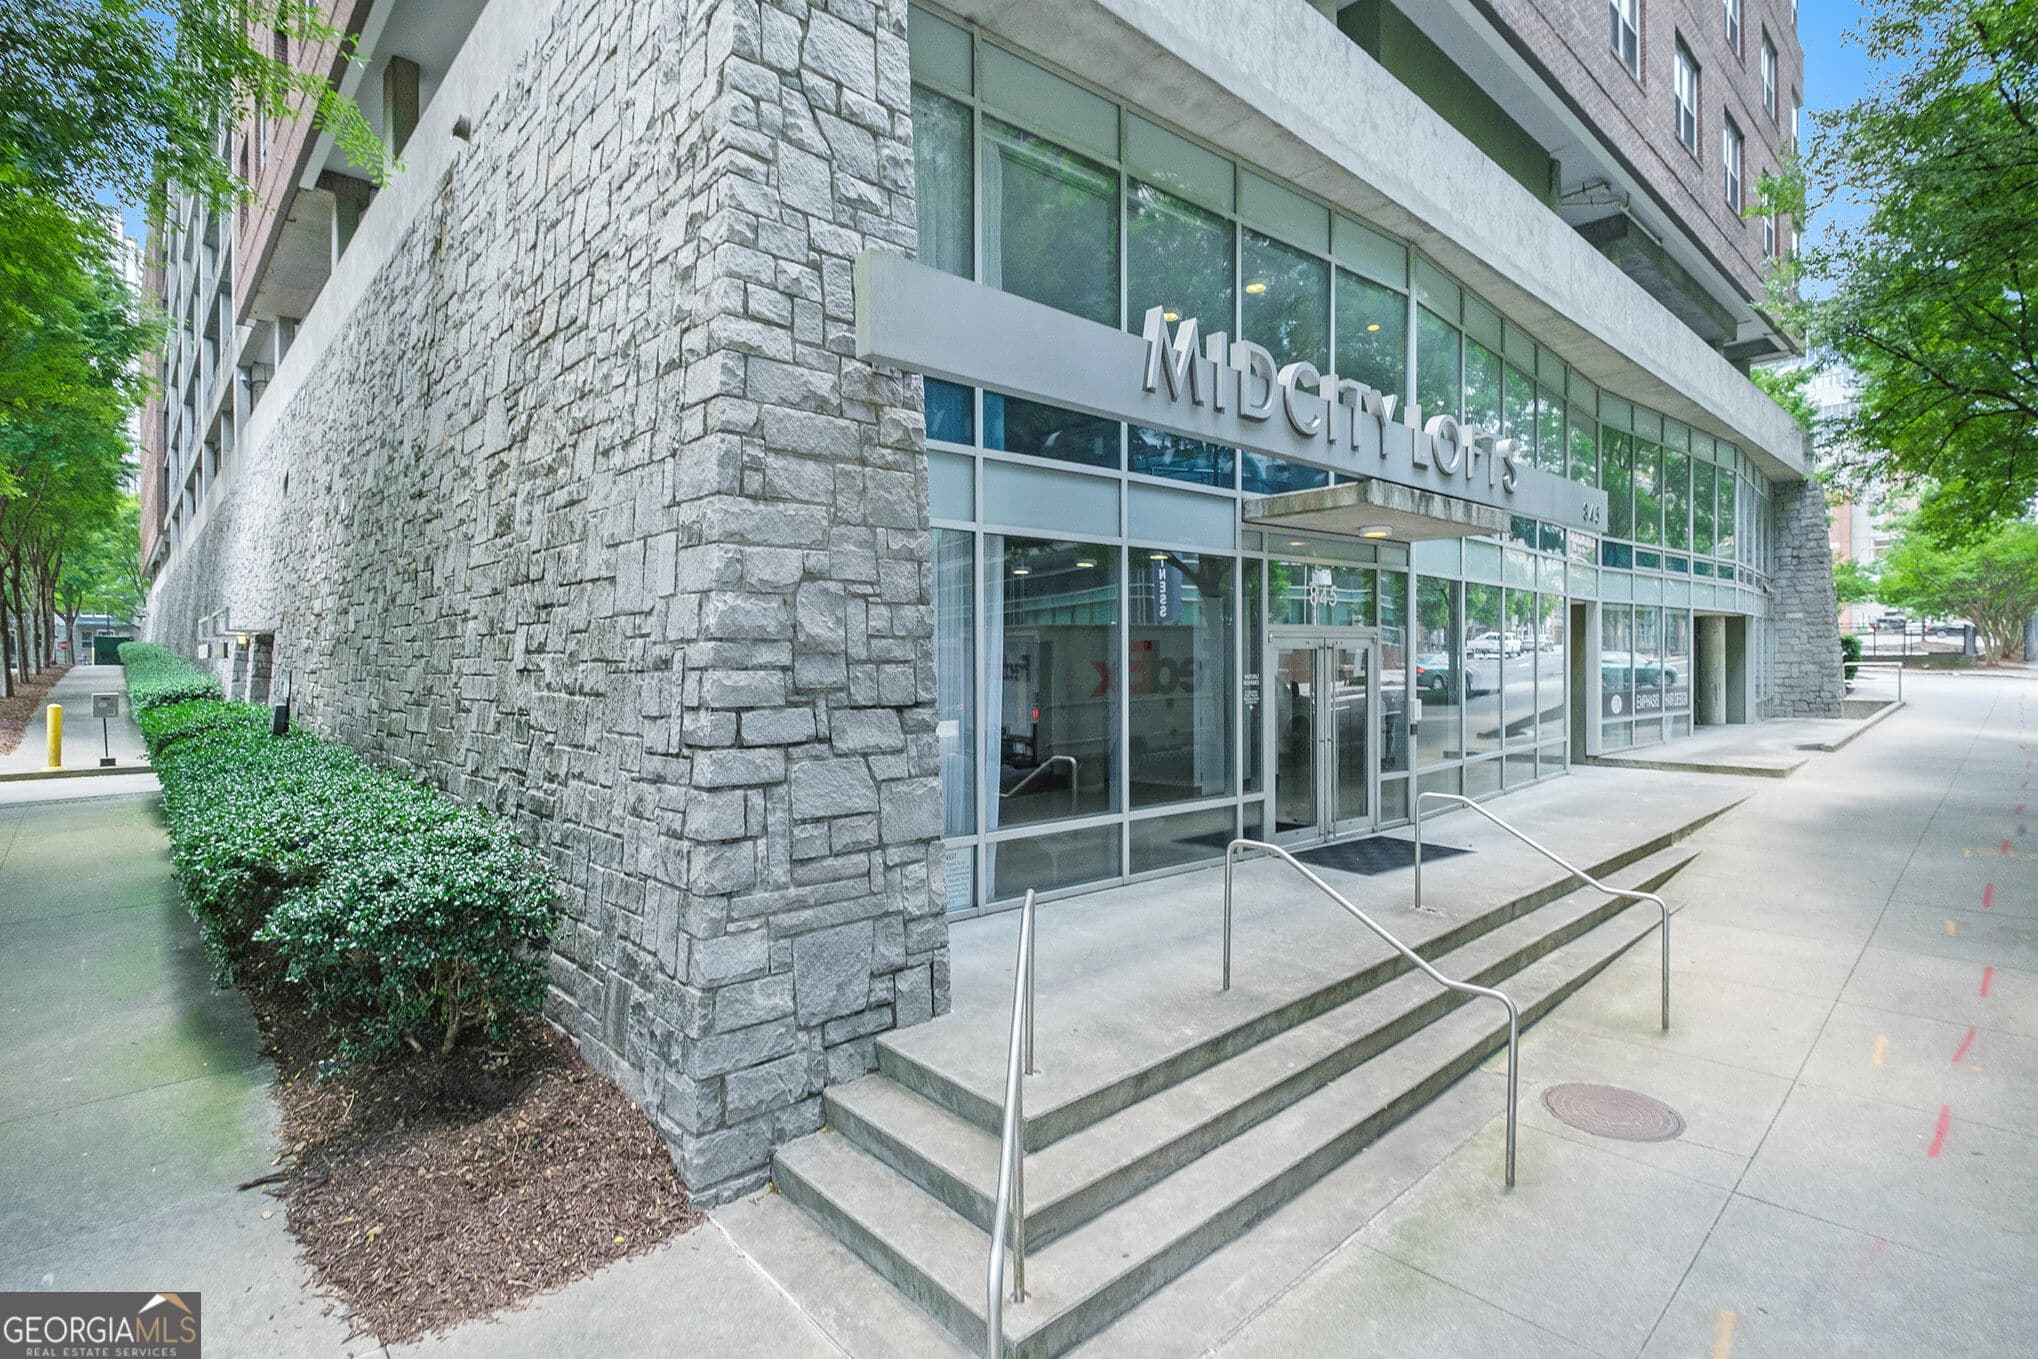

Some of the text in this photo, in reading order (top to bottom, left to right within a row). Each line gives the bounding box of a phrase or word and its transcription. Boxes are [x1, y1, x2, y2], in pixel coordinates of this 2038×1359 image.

[1142, 305, 1518, 495] MIDCITY LOFTS
[1309, 584, 1338, 607] 845
